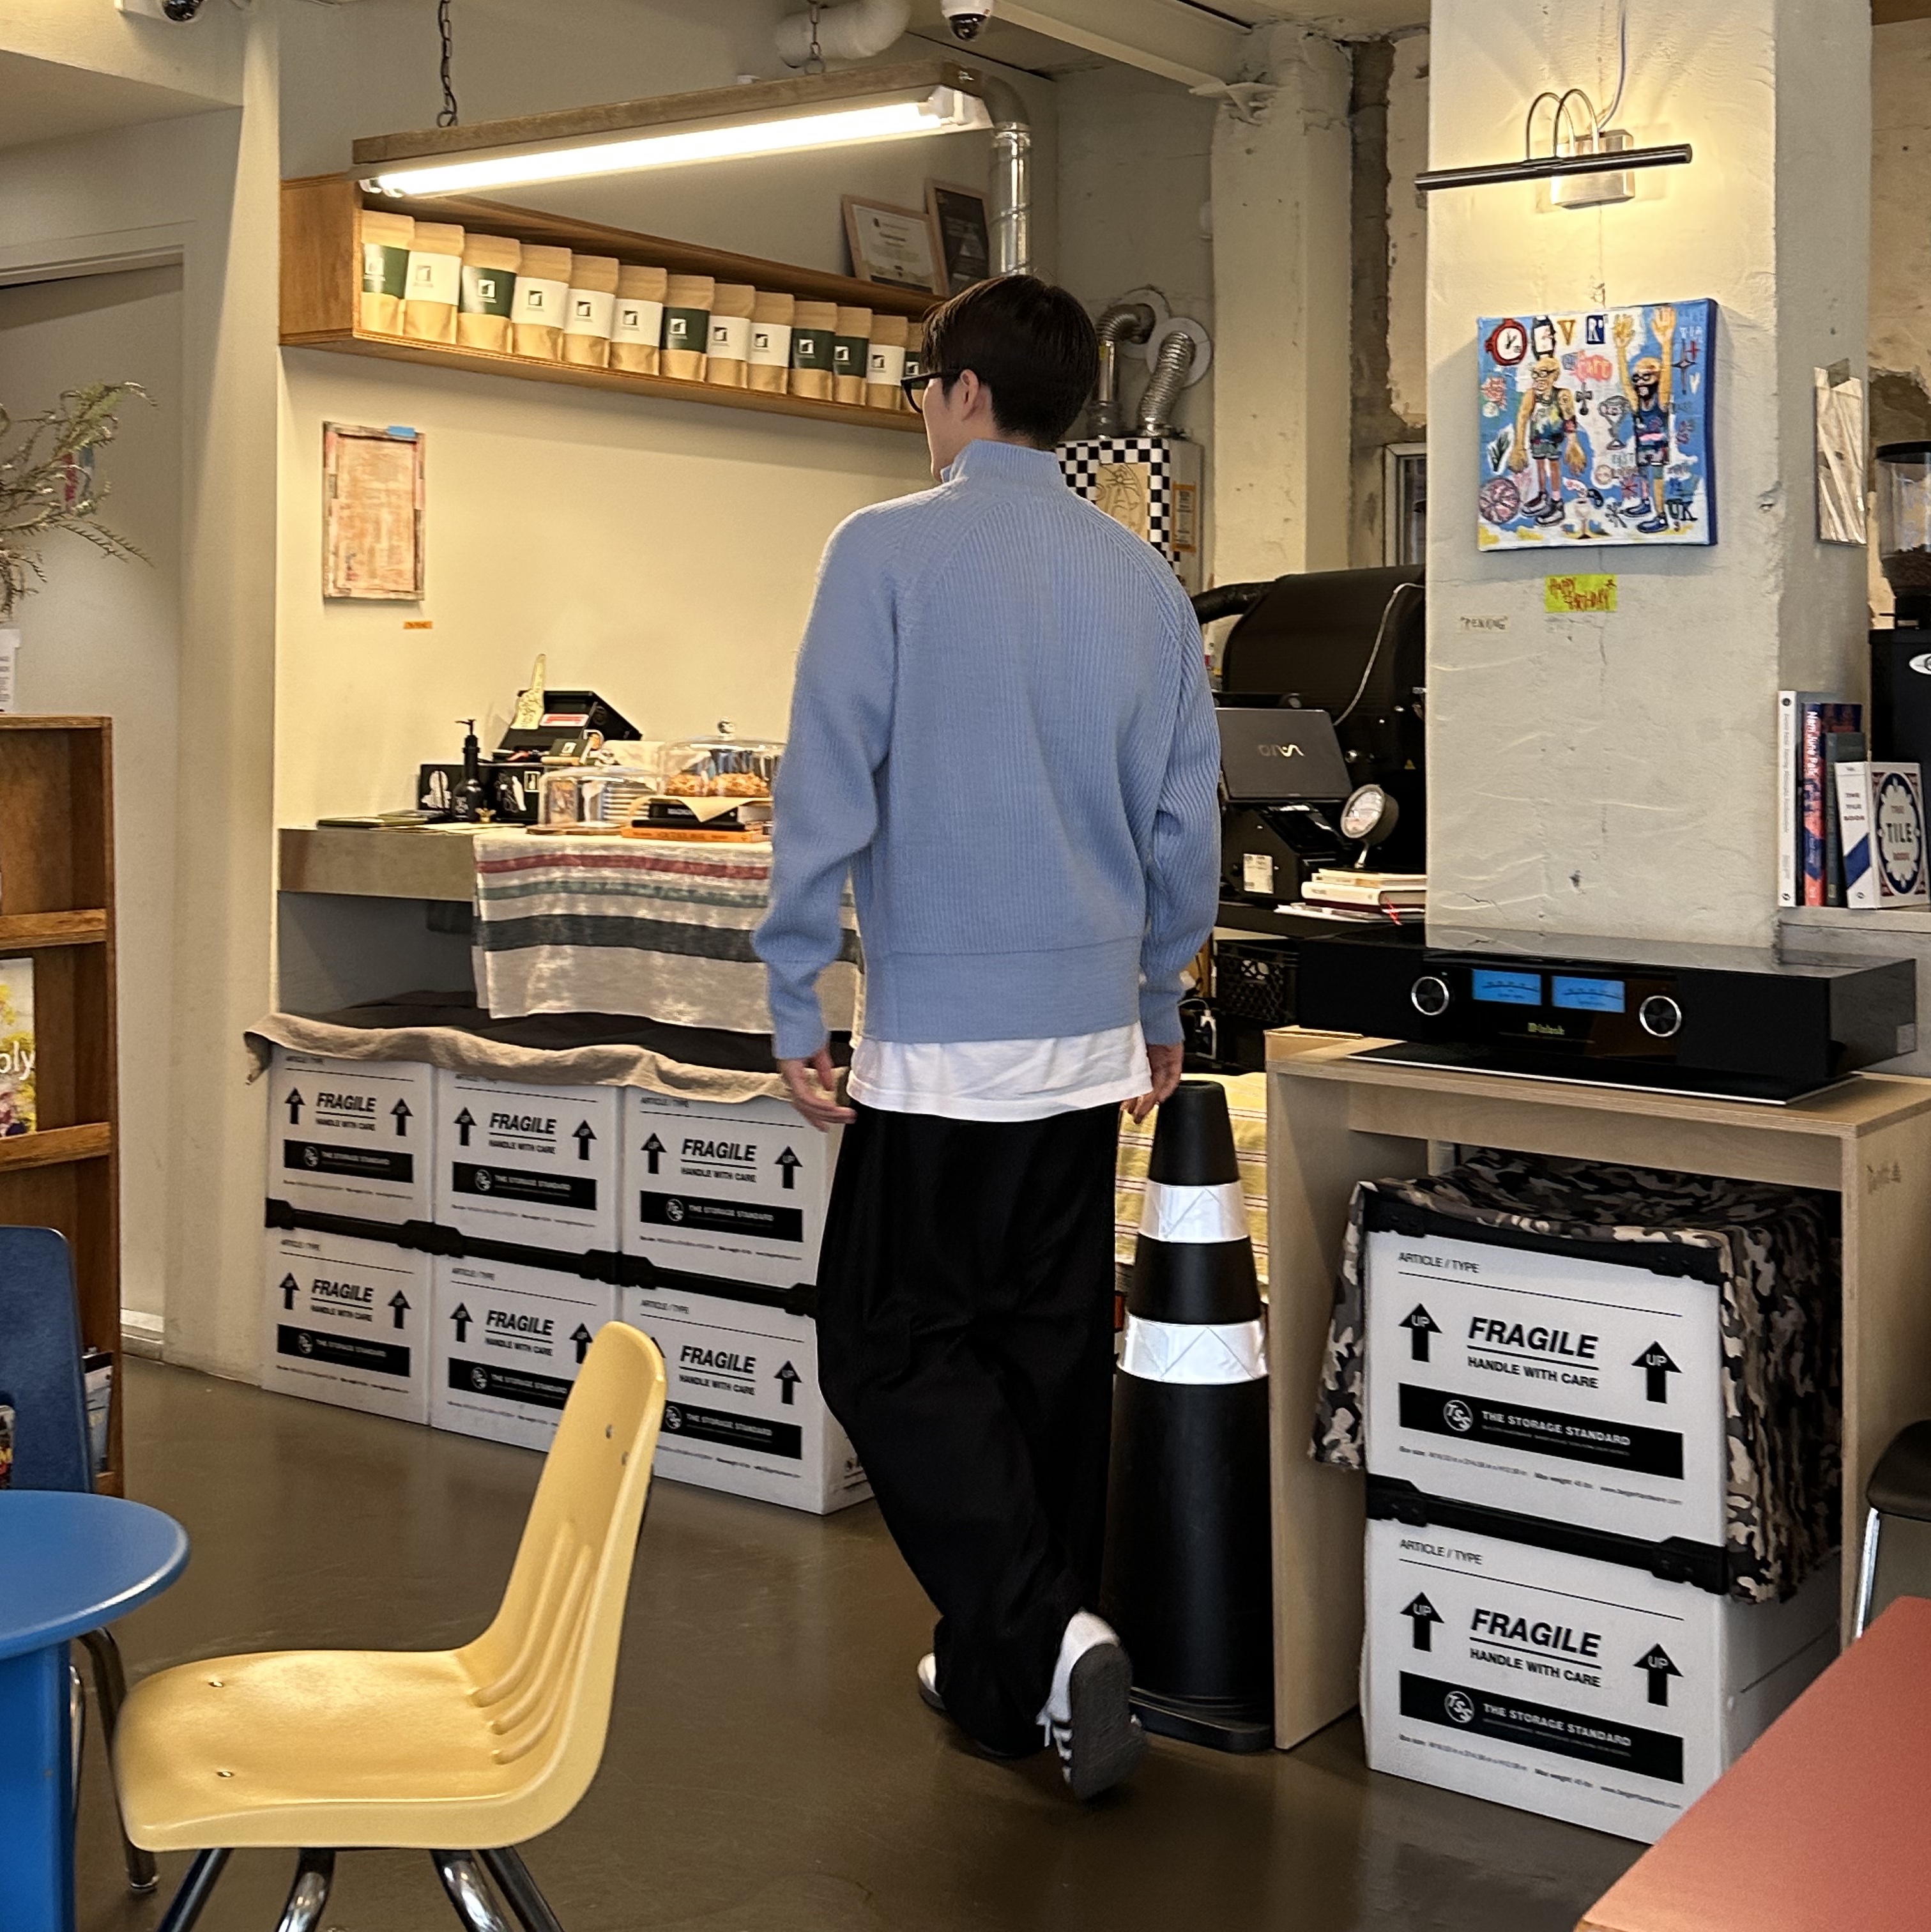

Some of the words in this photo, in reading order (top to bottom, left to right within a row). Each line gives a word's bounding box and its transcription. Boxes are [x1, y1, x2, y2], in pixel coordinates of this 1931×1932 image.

[1886, 822, 1912, 843] TILE
[316, 1092, 376, 1113] FRAGILE
[489, 1112, 557, 1134] FRAGILE
[682, 1138, 757, 1162] FRAGILE
[1399, 1252, 1443, 1268] ARTICLE
[1452, 1260, 1479, 1273] TYPE
[312, 1279, 374, 1303] FRAGILE
[486, 1310, 554, 1336] FRAGILE
[1411, 1315, 1430, 1328] UP
[1469, 1317, 1599, 1359] FRAGILE
[680, 1345, 756, 1374] FRAGILE
[1646, 1354, 1667, 1366] UP
[1468, 1356, 1520, 1375] HANDLE
[1523, 1366, 1557, 1382] WITH
[1561, 1373, 1599, 1389] CARE
[1481, 1411, 1505, 1423] THE
[1507, 1415, 1562, 1434] STORAGE
[1566, 1426, 1631, 1446] STANDARD
[1400, 1539, 1444, 1557] ARTICLE
[1454, 1549, 1483, 1565] TYPE
[1413, 1603, 1431, 1616] UP
[1471, 1608, 1601, 1657] FRAGILE
[1470, 1648, 1523, 1670] HANDLE
[1526, 1661, 1561, 1678] WITH
[1564, 1669, 1601, 1688] CARE
[1648, 1655, 1668, 1669] UP
[1483, 1703, 1506, 1717] THE
[1509, 1710, 1564, 1731] STORAGE
[1567, 1724, 1631, 1746] STANDARD
